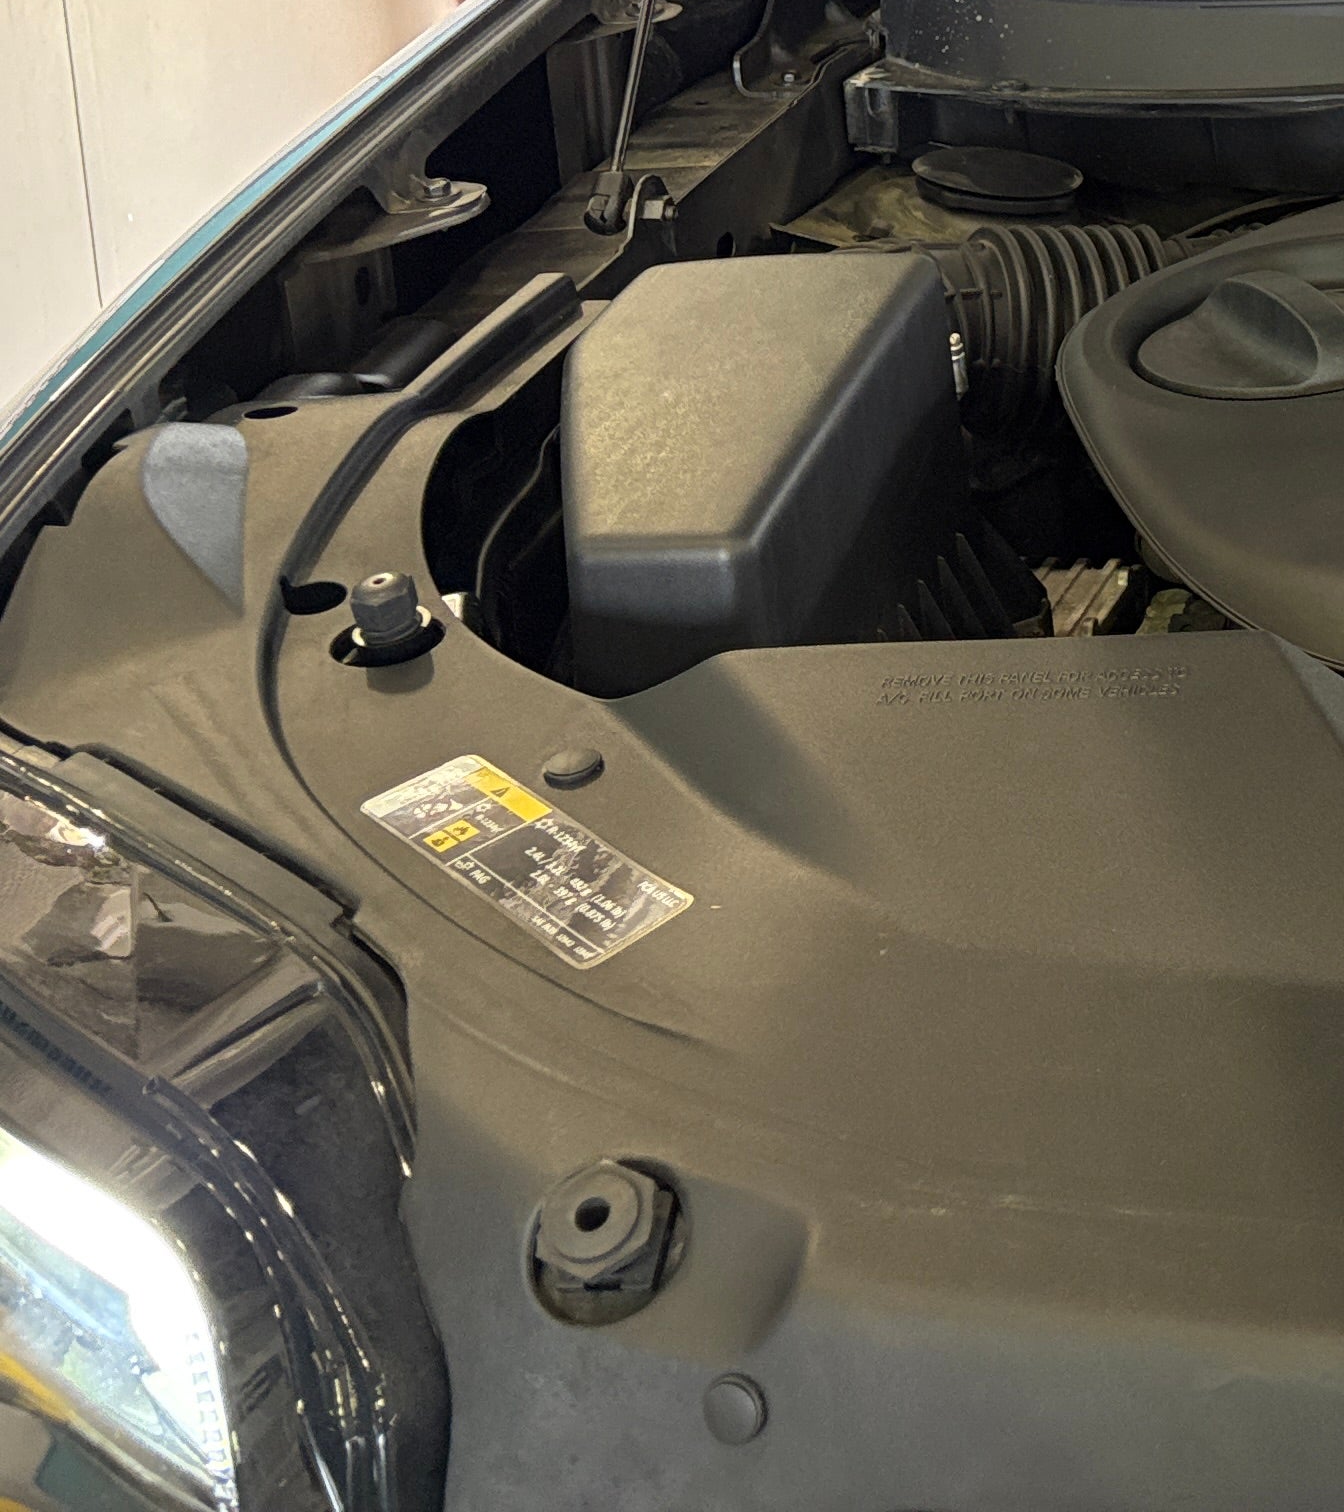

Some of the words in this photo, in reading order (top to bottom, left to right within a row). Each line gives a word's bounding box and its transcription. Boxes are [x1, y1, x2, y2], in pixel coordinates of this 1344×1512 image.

[881, 674, 952, 688] REMOVE
[959, 672, 995, 686] THIS
[1000, 671, 1051, 684] PANEL
[1057, 670, 1090, 683] FOR
[918, 689, 952, 703] FILL
[960, 688, 1006, 702] PORT
[1011, 688, 1039, 700] ON
[1099, 684, 1181, 698] VEHICLES
